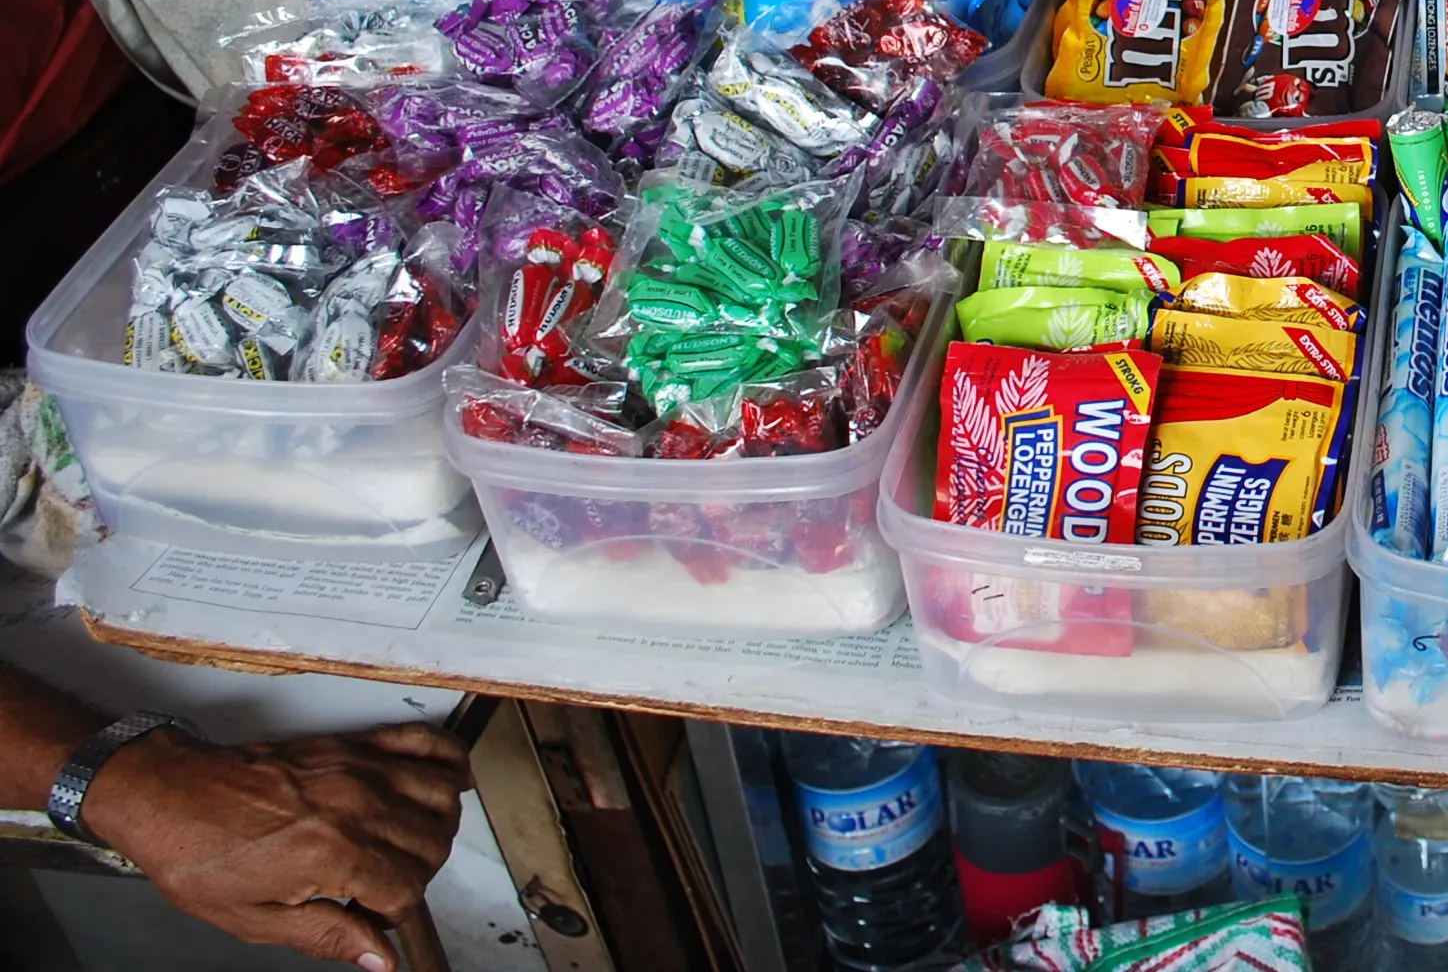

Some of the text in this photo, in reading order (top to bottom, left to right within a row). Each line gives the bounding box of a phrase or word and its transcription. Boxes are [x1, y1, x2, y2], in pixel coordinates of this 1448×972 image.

[1428, 26, 1438, 71] LOZENGES
[726, 236, 770, 276] HUDSON'S
[672, 335, 740, 351] HUDSON'S
[1115, 358, 1144, 395] STRONG
[1005, 432, 1036, 534] LOZENGE
[1028, 429, 1054, 539] PEPPERMIN
[1060, 399, 1125, 544] WOOD
[810, 790, 916, 833] POLAR
